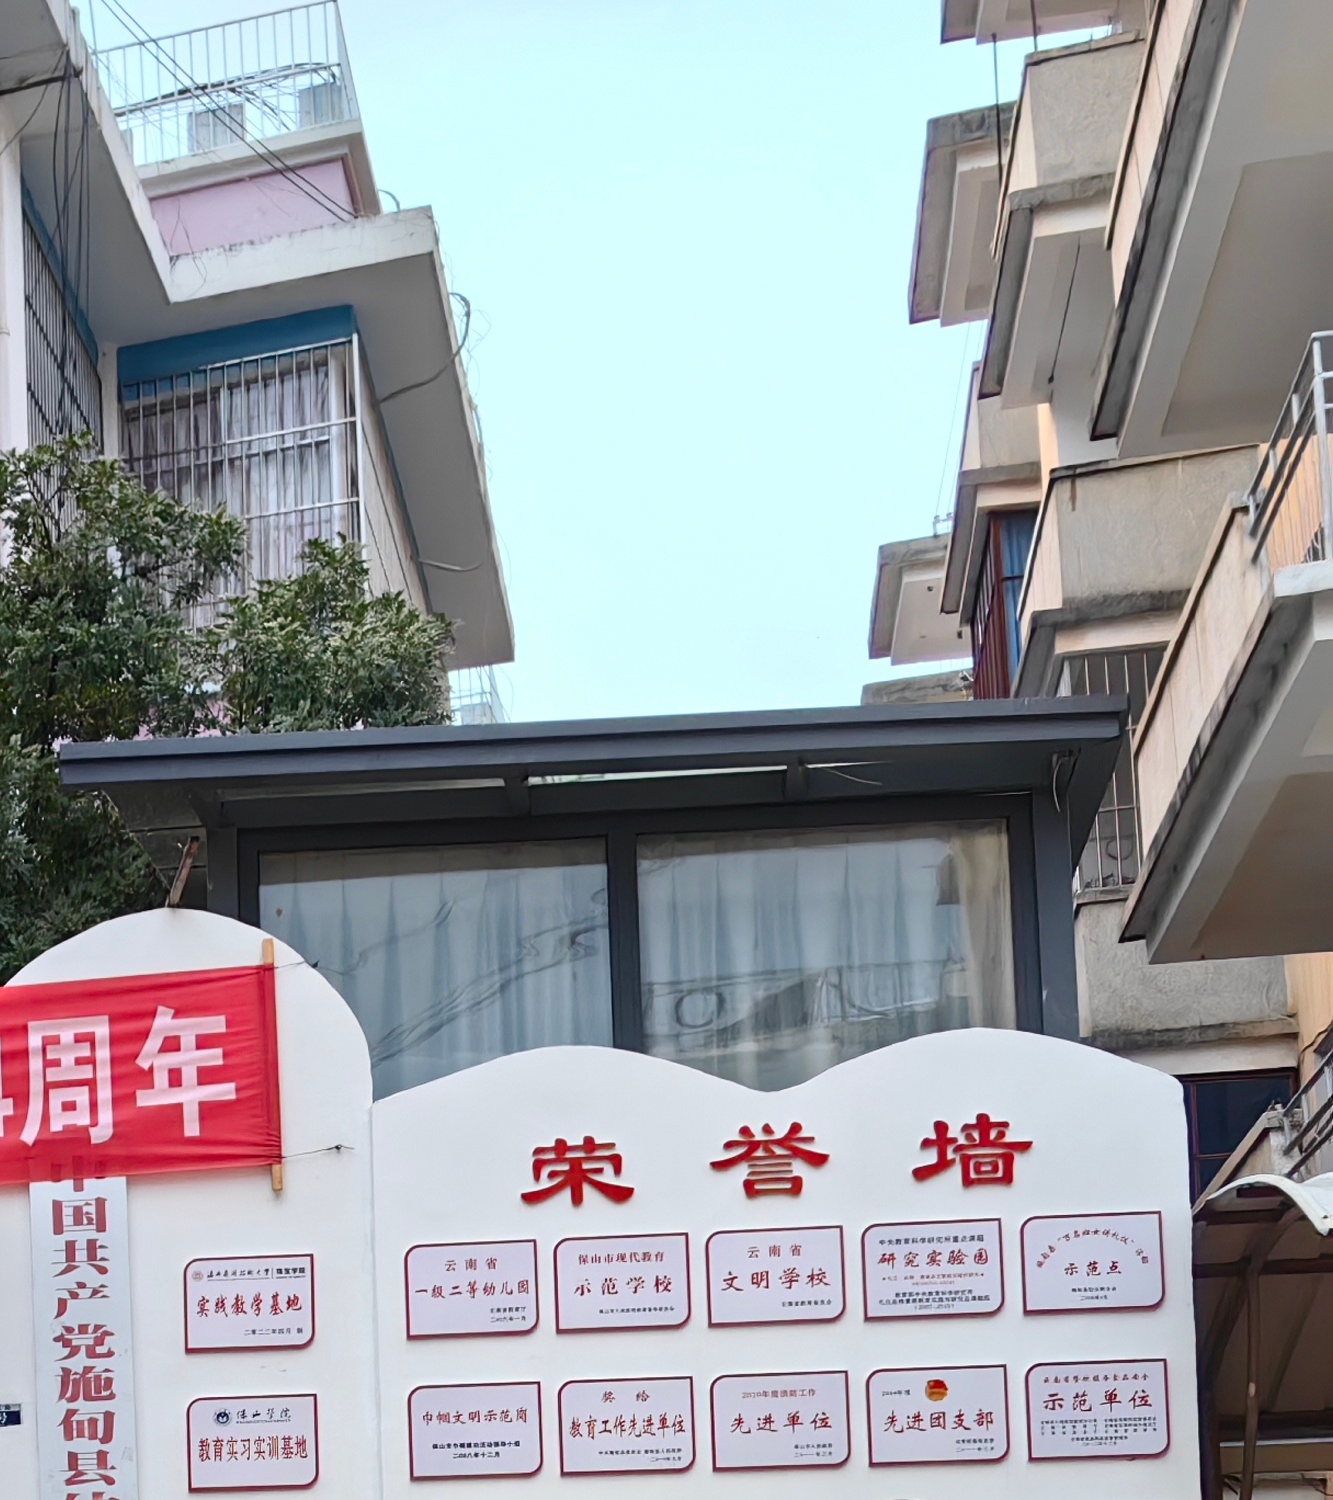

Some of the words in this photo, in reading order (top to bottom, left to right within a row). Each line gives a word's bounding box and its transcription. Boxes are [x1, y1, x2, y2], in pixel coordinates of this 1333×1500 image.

[521, 1113, 1033, 1206] 荣誉墙
[578, 1251, 664, 1265] 保山市现代教育
[747, 1244, 802, 1258] 云南省
[877, 1248, 988, 1269] 研究实验园
[445, 1257, 497, 1271] 云南省
[1064, 1261, 1121, 1276] 示范点
[415, 1280, 529, 1299] 一级二等幼儿园
[574, 1275, 672, 1296] 示范学校
[721, 1267, 831, 1291] 文明学校
[197, 1291, 302, 1317] 实践教学基地
[1043, 1387, 1152, 1412] 示范单位
[423, 1407, 527, 1426] 巾帼文明示范岗
[570, 1412, 685, 1440] 教育工作先进单位
[730, 1410, 832, 1434] 先进单位
[884, 1408, 994, 1433] 先进团支部
[198, 1435, 308, 1462] 教育实习实训基地
